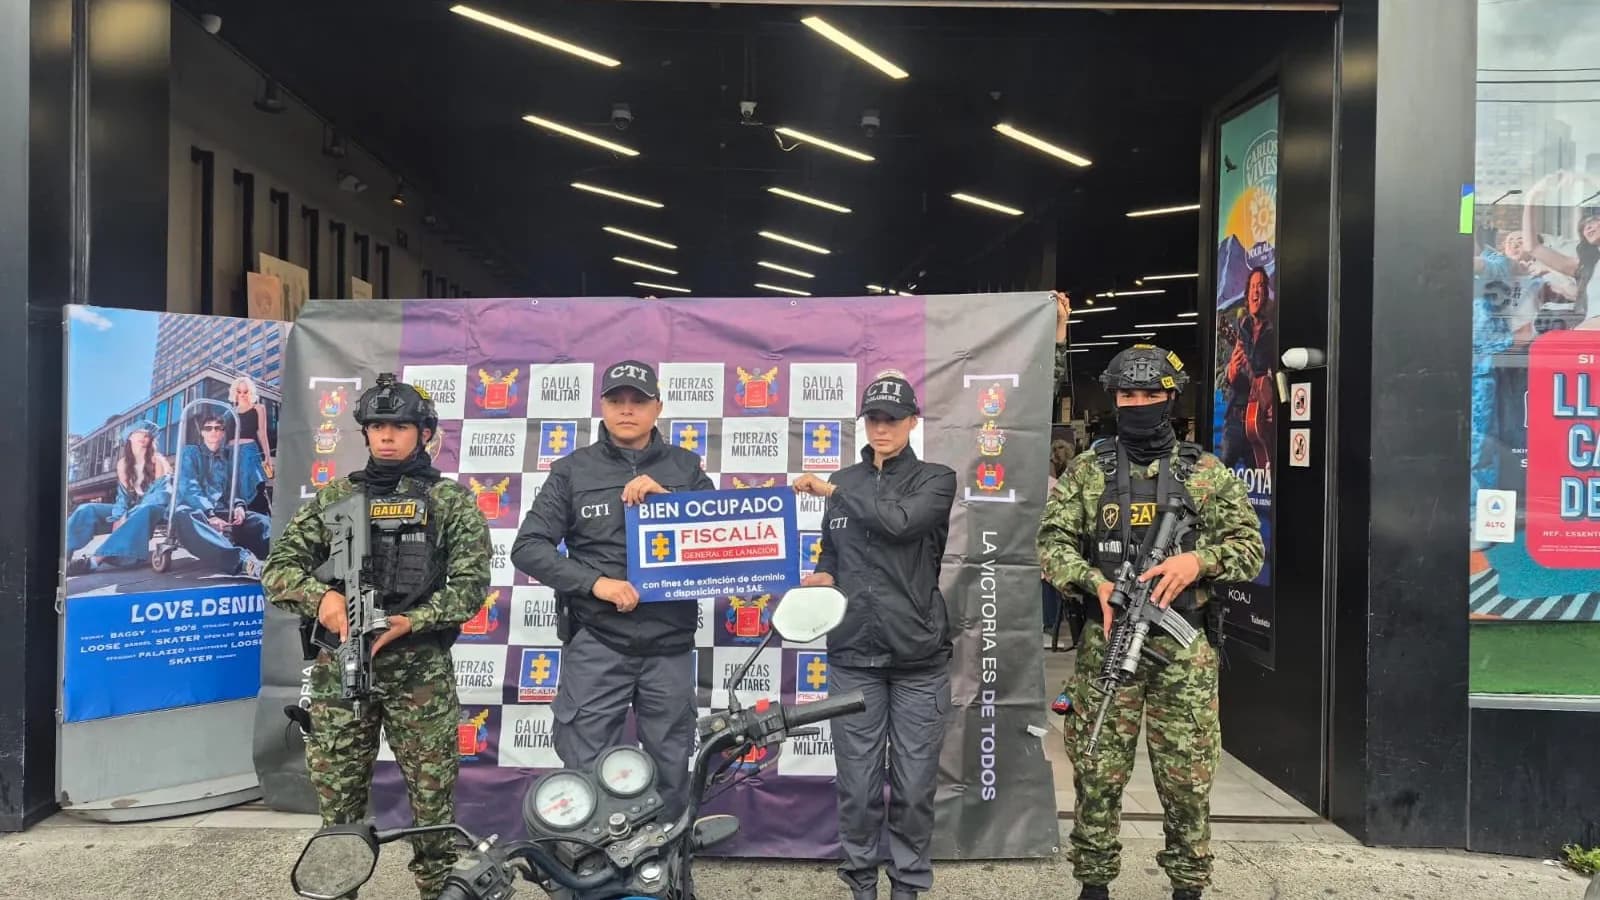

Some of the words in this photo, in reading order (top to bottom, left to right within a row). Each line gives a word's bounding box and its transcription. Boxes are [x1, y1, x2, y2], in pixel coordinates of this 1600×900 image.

[1578, 354, 1595, 365] SI
[610, 365, 648, 382] CTI
[541, 376, 580, 389] GAULA
[669, 377, 713, 389] FUERZAS
[803, 376, 843, 389] GAULA
[867, 381, 903, 397] CTI
[430, 391, 456, 404] TARES
[541, 389, 580, 401] MILITAR
[668, 390, 714, 402] MILITARES
[803, 389, 843, 401] MILITAR
[472, 432, 516, 444] FUERZAS
[733, 431, 778, 444] FUERZAS
[469, 445, 515, 457] MILITARES
[731, 445, 778, 457] MILITARES
[373, 504, 412, 516] GAULA
[581, 504, 610, 519] CTI
[640, 501, 680, 519] BIEN
[685, 496, 783, 517] OCUPADO
[829, 517, 849, 530] CTI
[681, 521, 777, 544] FISCALÍA
[982, 531, 998, 555] LA
[684, 550, 721, 560] GENERAL
[723, 549, 734, 558] DE
[735, 548, 745, 557] LA
[661, 579, 681, 588] fines
[683, 578, 695, 586] de
[697, 575, 736, 586] extinción
[738, 575, 749, 583] de
[751, 573, 785, 582] dominio
[673, 586, 720, 598] disposición
[723, 584, 734, 593] de
[736, 584, 745, 593] la
[1229, 589, 1251, 604] KOAJ
[525, 600, 556, 614] GAUL
[980, 559, 997, 652] VICTORIA
[524, 614, 557, 627] MILITA
[110, 630, 145, 639] BAGGY
[80, 643, 121, 653] LOOSE
[155, 634, 201, 645] SKATER
[138, 648, 185, 658] PALAZZO
[168, 654, 213, 666] SKATER
[454, 660, 494, 673] UERZAS
[982, 657, 997, 684] ES
[981, 690, 996, 718] DE
[981, 723, 996, 800] TODOS
